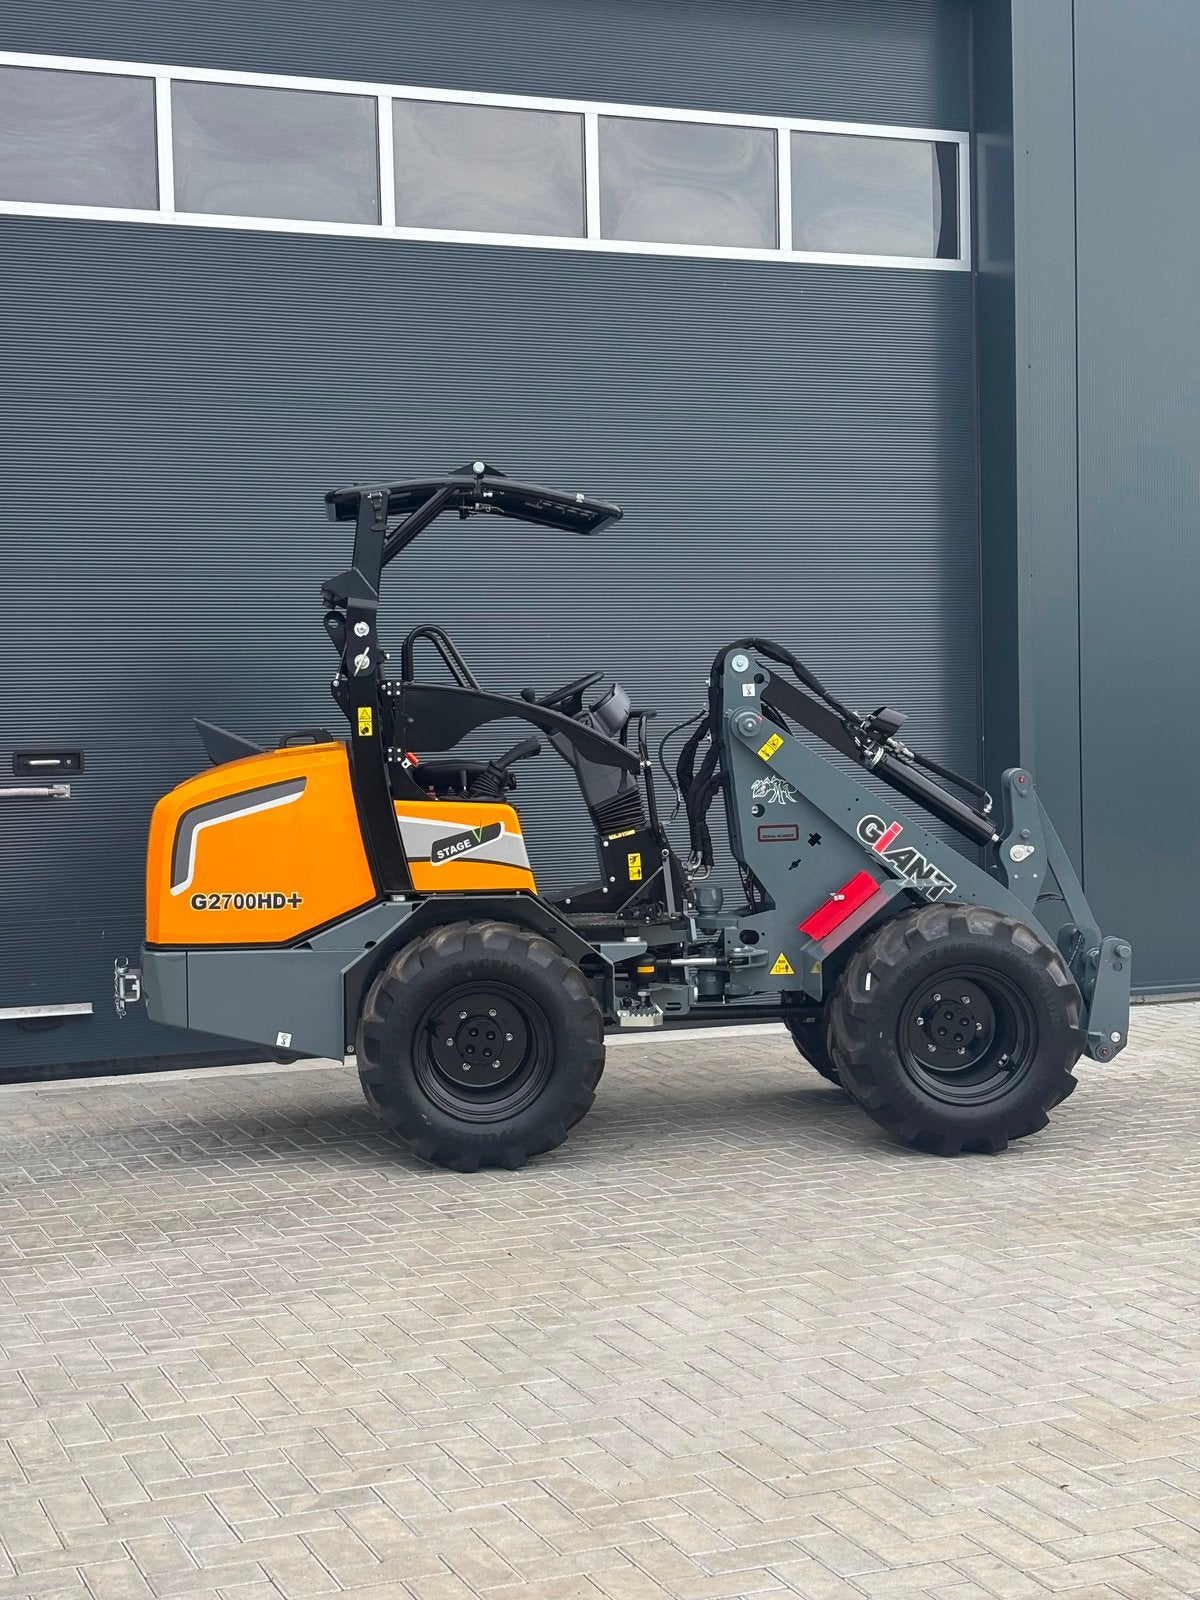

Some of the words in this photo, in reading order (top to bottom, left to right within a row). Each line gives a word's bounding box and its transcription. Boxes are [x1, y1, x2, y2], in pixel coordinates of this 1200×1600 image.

[436, 838, 472, 859] STAGE
[471, 820, 483, 843] V
[190, 892, 303, 911] G2700HD+
